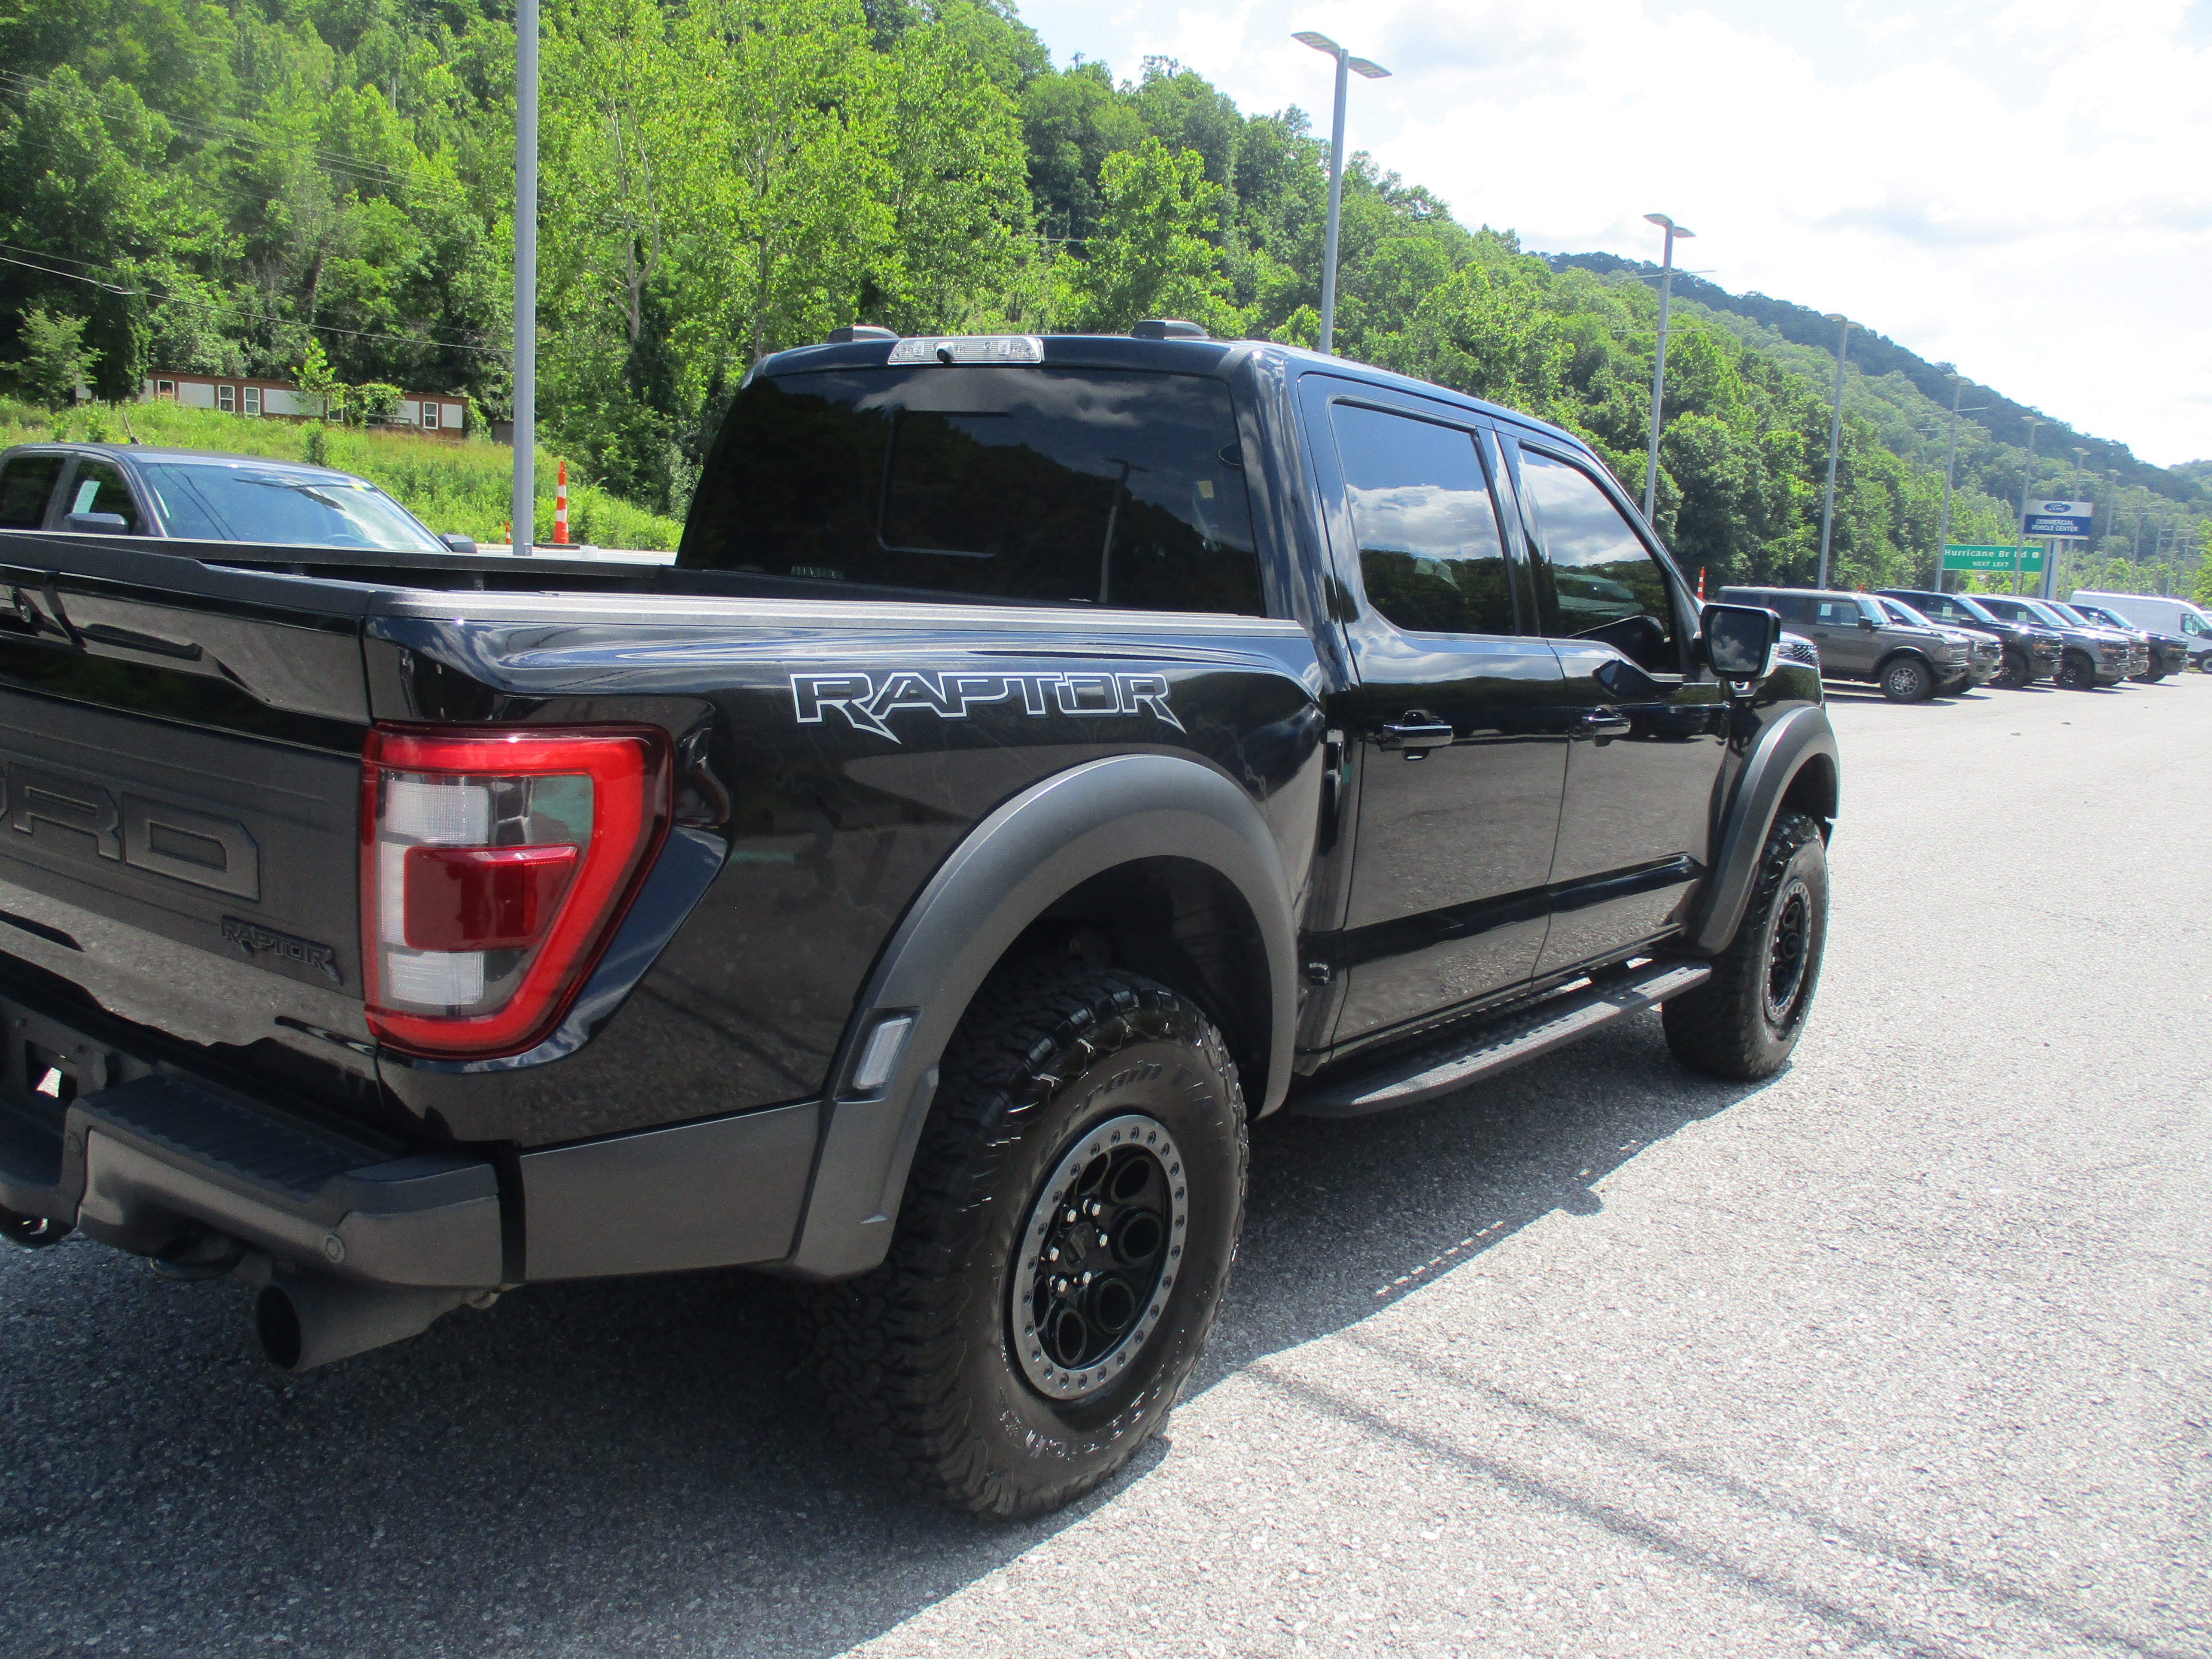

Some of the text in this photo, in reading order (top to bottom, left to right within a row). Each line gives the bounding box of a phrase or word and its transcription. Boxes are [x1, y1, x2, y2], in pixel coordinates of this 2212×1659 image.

[789, 672, 1187, 744] RAPTOR
[0, 761, 260, 903] RD
[221, 915, 343, 986] RAPTOR
